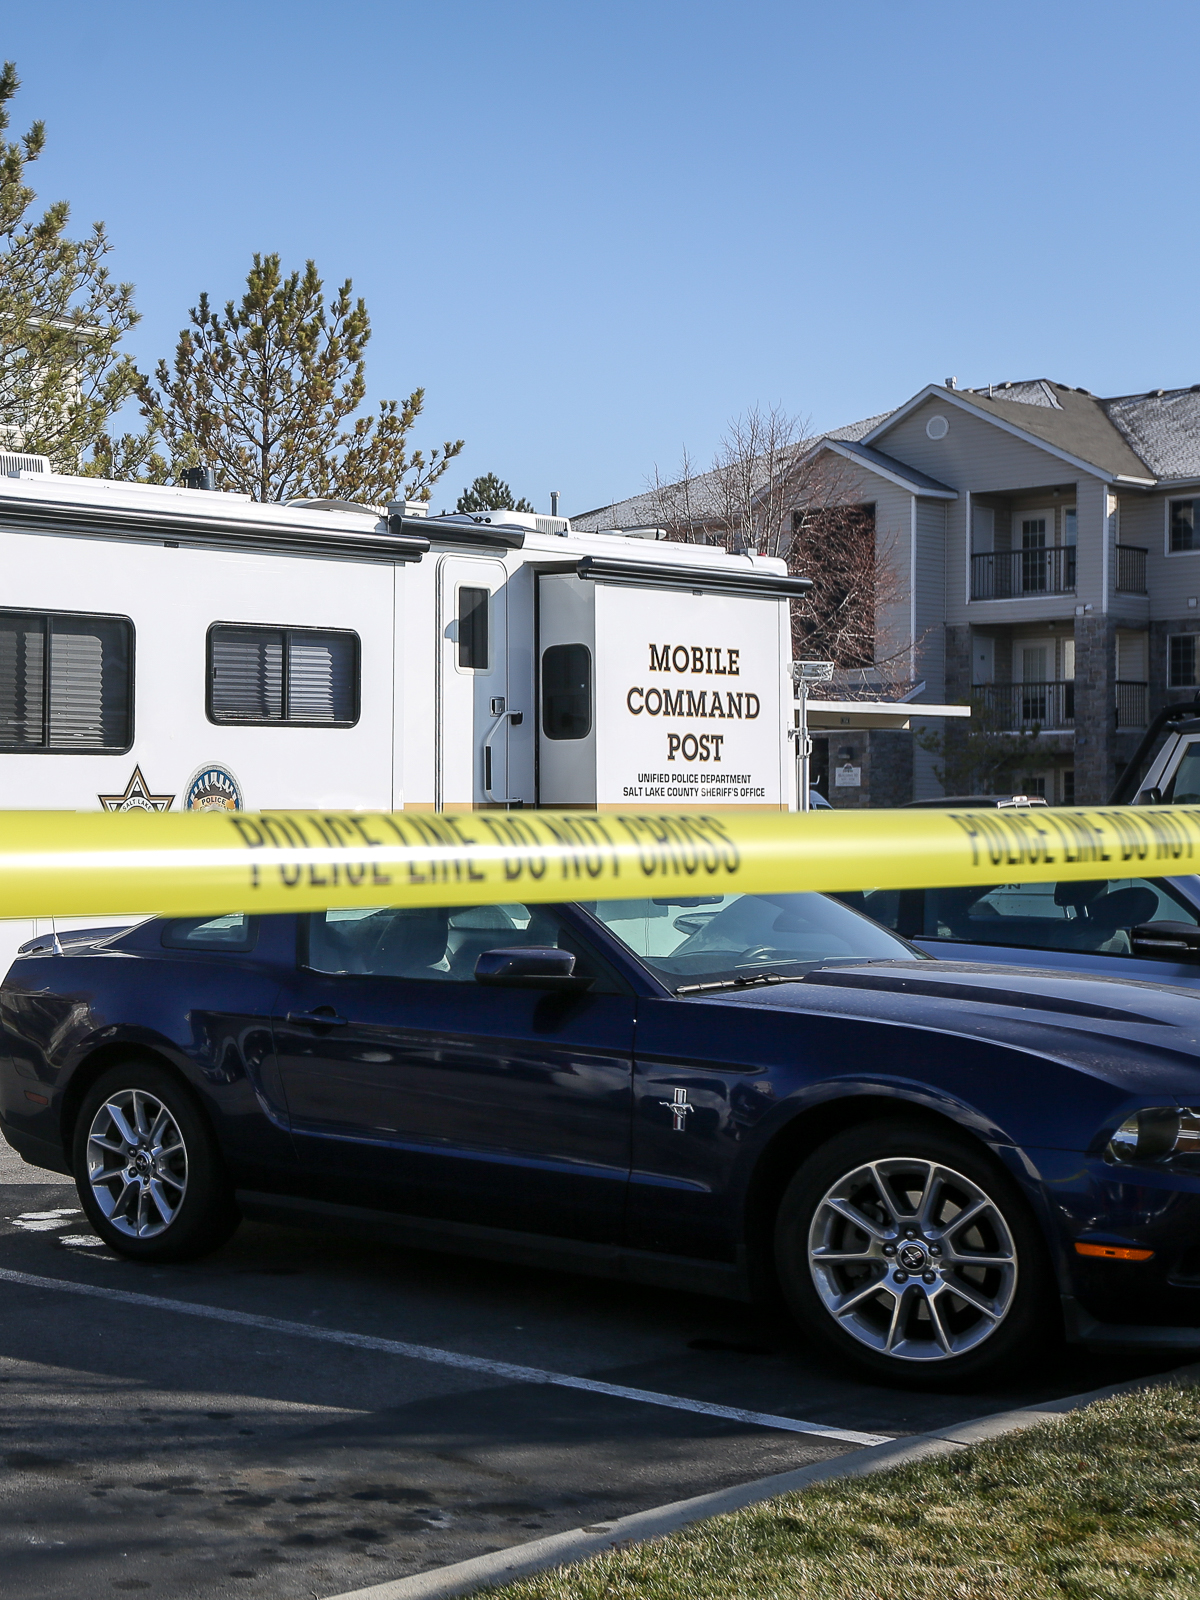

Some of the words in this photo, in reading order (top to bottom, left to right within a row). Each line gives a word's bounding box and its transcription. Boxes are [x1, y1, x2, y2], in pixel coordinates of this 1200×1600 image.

[648, 643, 740, 676] MOBILE
[626, 686, 761, 720] COMMAND
[667, 732, 724, 762] POST
[623, 787, 643, 797] SALT
[645, 787, 666, 797] LAKE
[667, 787, 699, 797] COUNTY
[701, 788, 739, 797] SHERIFF'S
[740, 788, 766, 797] OFFICE
[637, 773, 670, 783] UNIFIED
[671, 774, 699, 784] POLICE
[700, 774, 751, 784] DEPARTMENT
[122, 799, 136, 812] SALT
[137, 800, 152, 811] LAKE
[201, 797, 227, 805] POLICE
[229, 815, 392, 888] POLICE
[383, 814, 486, 884] LINE
[480, 816, 547, 881] DO
[537, 815, 620, 879] NOT
[615, 815, 741, 877] CROSS
[947, 812, 1054, 867] POLICE
[1038, 811, 1112, 863] LINE
[1096, 811, 1148, 861] DO
[1135, 810, 1193, 859] NOT
